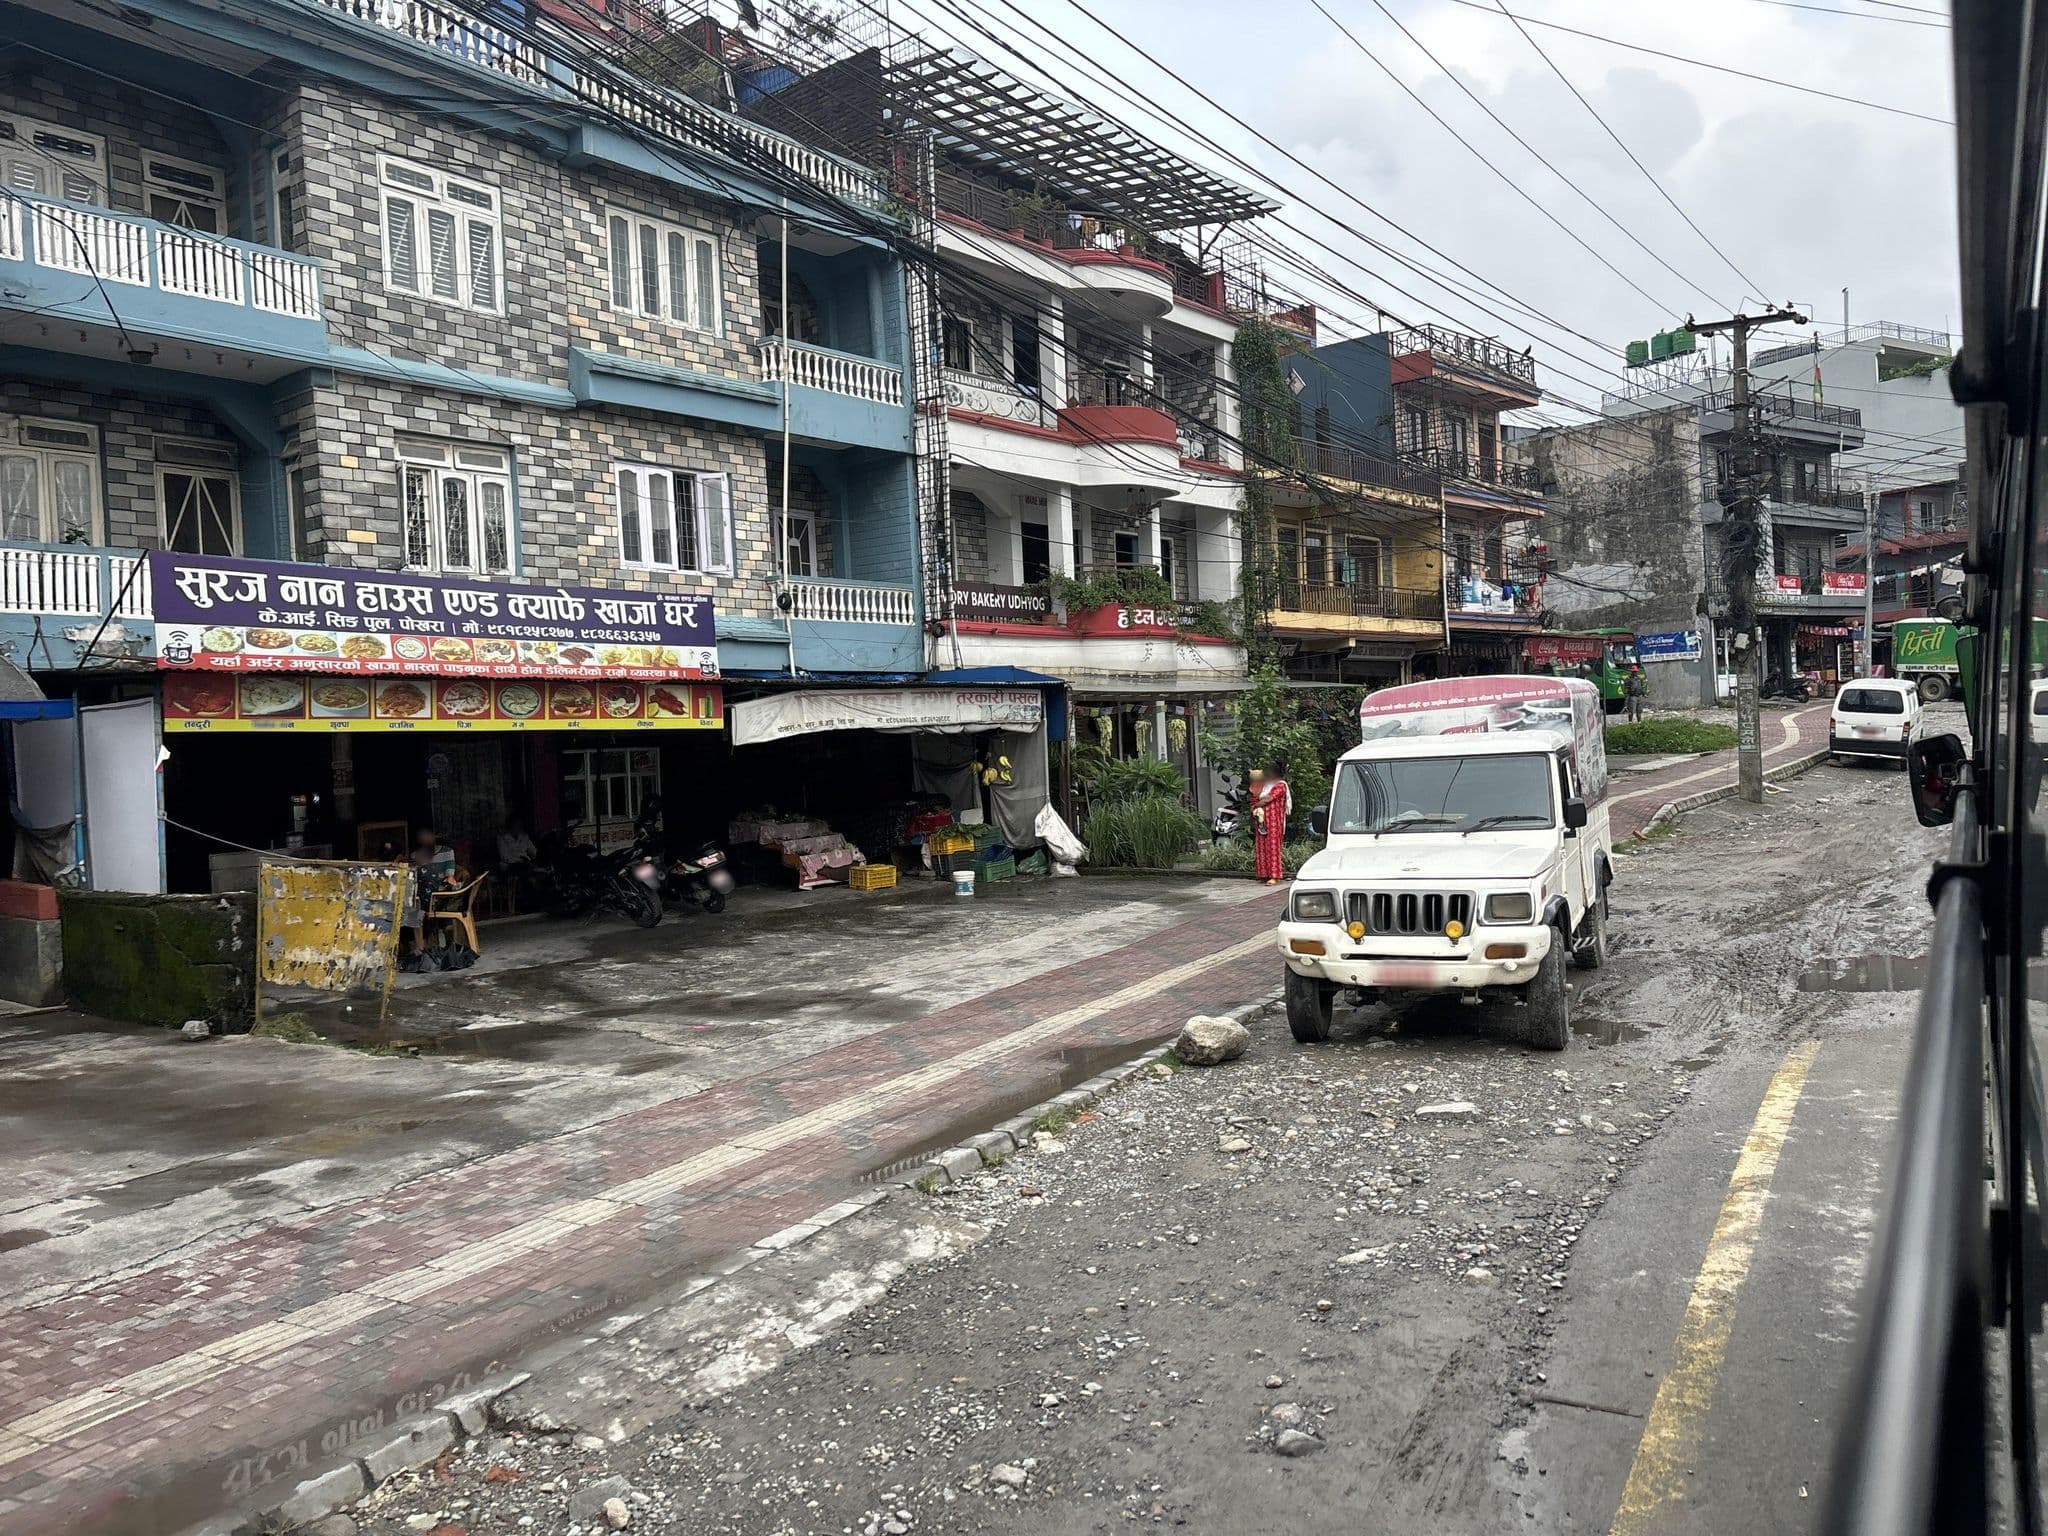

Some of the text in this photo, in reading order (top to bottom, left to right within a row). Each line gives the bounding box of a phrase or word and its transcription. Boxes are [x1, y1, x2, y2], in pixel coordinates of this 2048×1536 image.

[174, 566, 699, 628] सुरज नान हाउस एण्ड क्याफे खाजा घर
[971, 591, 1006, 609] BAKERY
[1008, 594, 1046, 611] UDHYOG
[325, 611, 359, 629] सिङ
[398, 616, 445, 633] पोखरा
[246, 656, 284, 668] अर्डर
[365, 661, 400, 672] खाजा
[404, 662, 439, 673] नास्ता
[521, 665, 542, 675] होम
[956, 689, 1005, 705] तरकारी
[1008, 692, 1039, 705] पसल
